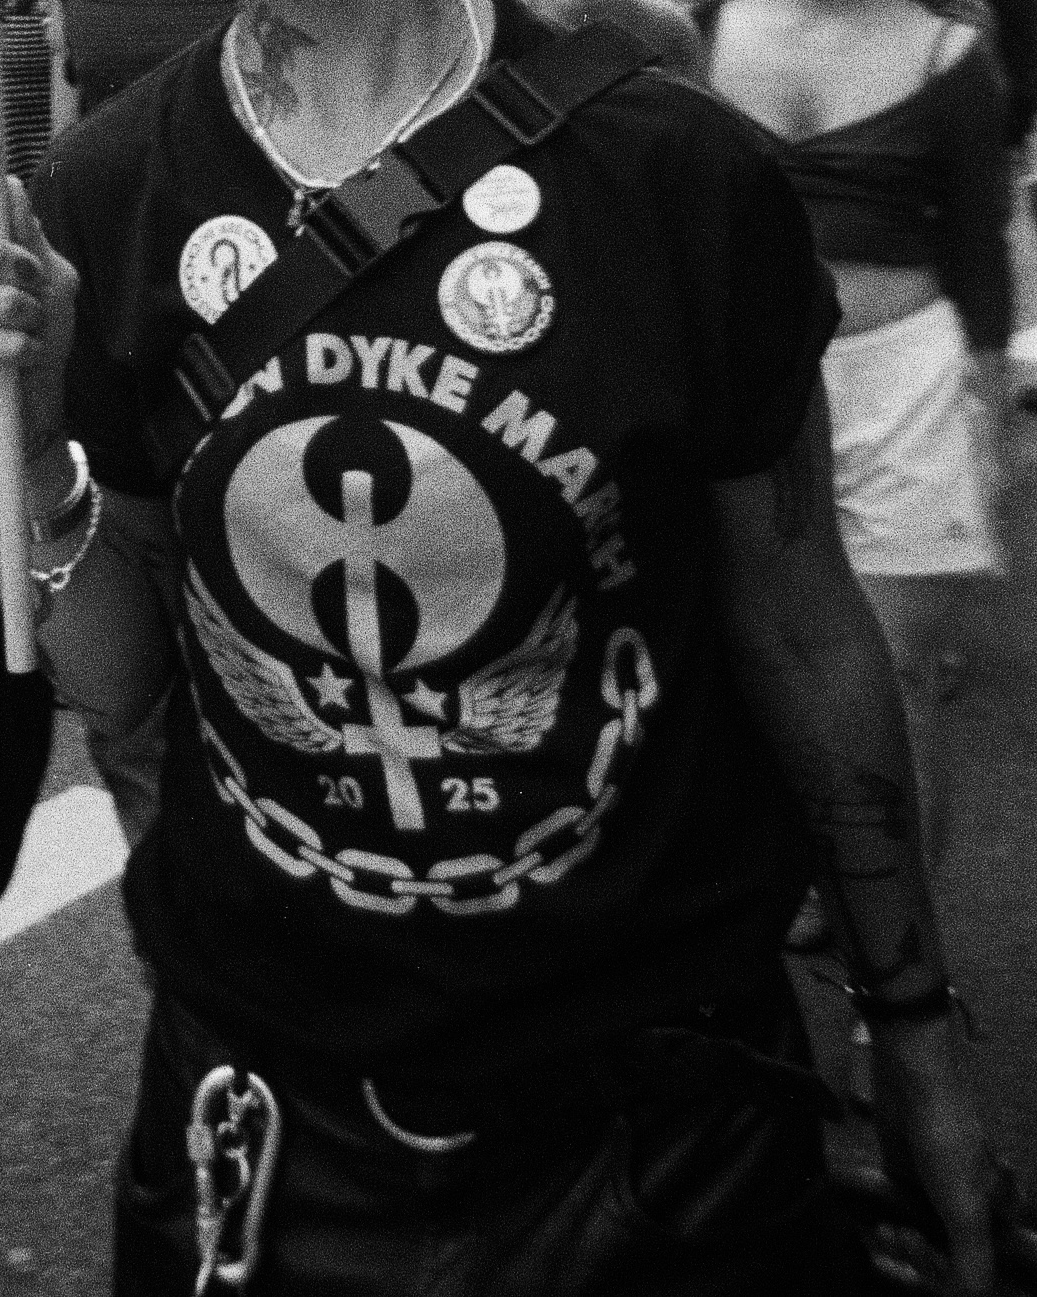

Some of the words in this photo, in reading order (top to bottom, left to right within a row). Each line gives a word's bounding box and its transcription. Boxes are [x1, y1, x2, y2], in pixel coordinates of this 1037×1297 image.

[305, 332, 479, 414] DYKE
[318, 776, 364, 808] 20
[440, 777, 500, 812] 25
